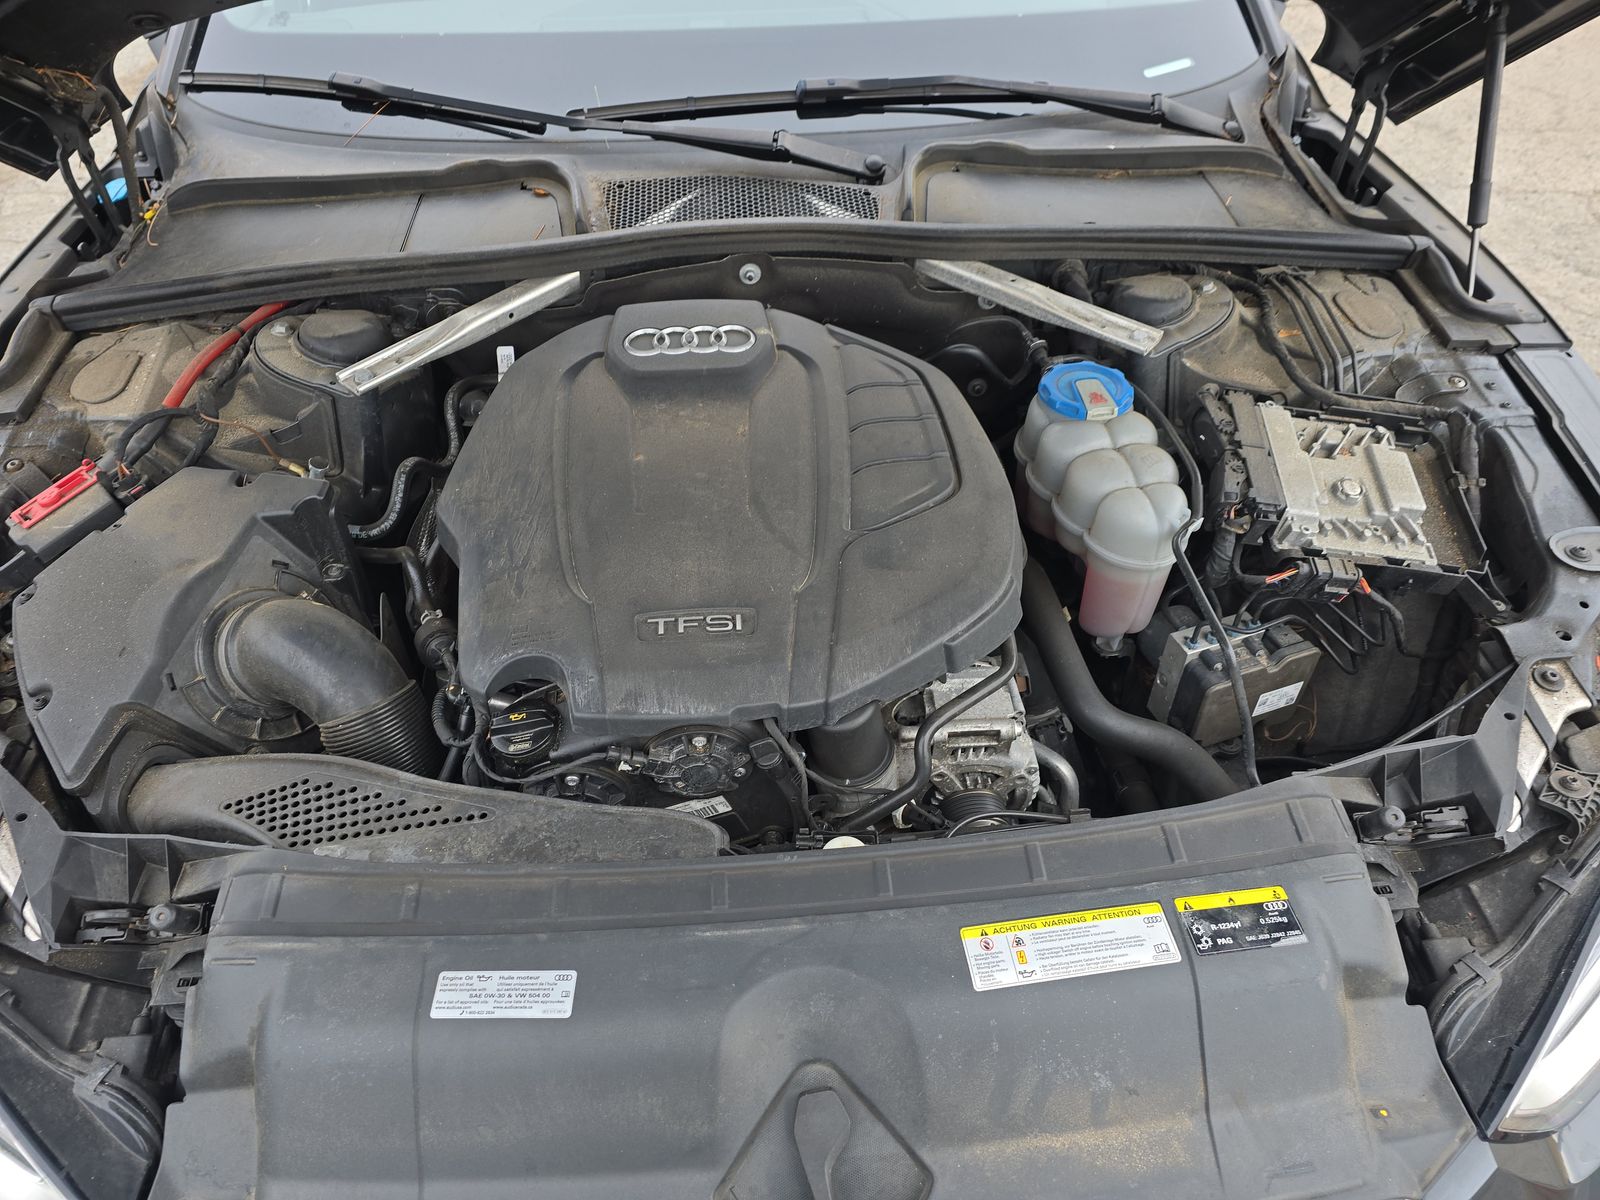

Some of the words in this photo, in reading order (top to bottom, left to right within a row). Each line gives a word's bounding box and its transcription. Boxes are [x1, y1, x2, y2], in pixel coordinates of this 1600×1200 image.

[647, 614, 742, 634] TFSI
[992, 922, 1037, 934] ACHTUNG
[1041, 916, 1087, 928] WARNING
[1092, 909, 1141, 921] ATTENTION
[1260, 916, 1288, 924] 0.525kg
[1210, 921, 1242, 930] R-1234yf
[1216, 937, 1233, 945] PAG
